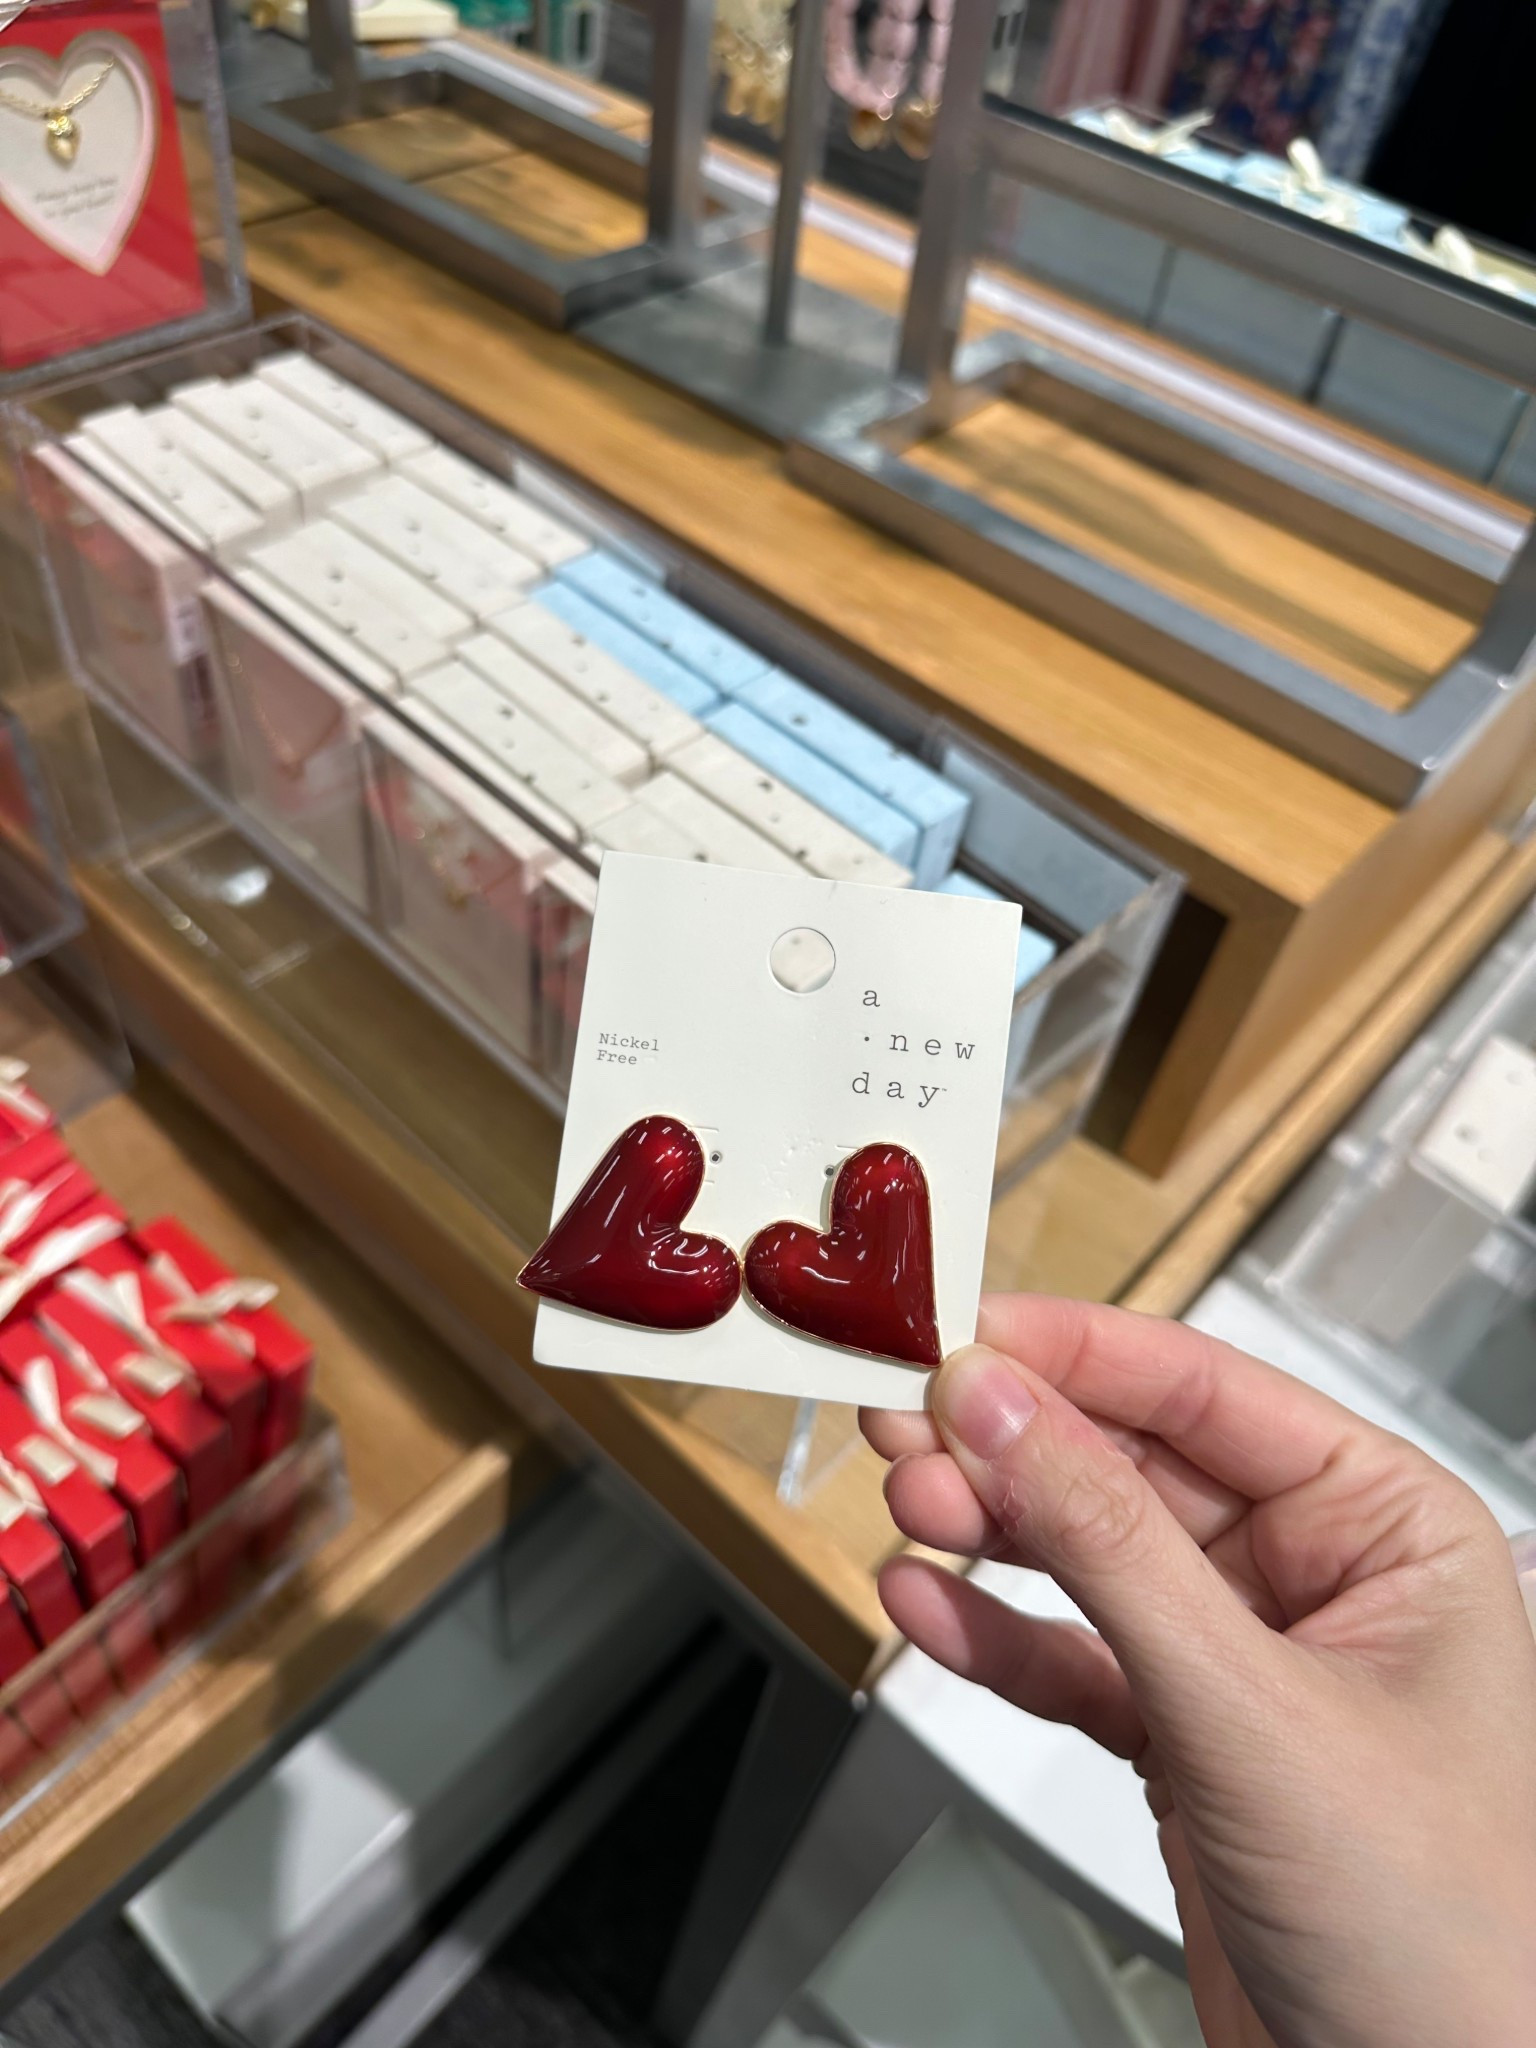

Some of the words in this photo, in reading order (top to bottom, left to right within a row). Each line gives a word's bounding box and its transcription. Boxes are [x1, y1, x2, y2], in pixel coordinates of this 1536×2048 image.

[862, 989, 881, 1008] a
[598, 1032, 660, 1052] Nickel
[596, 1049, 638, 1065] Free
